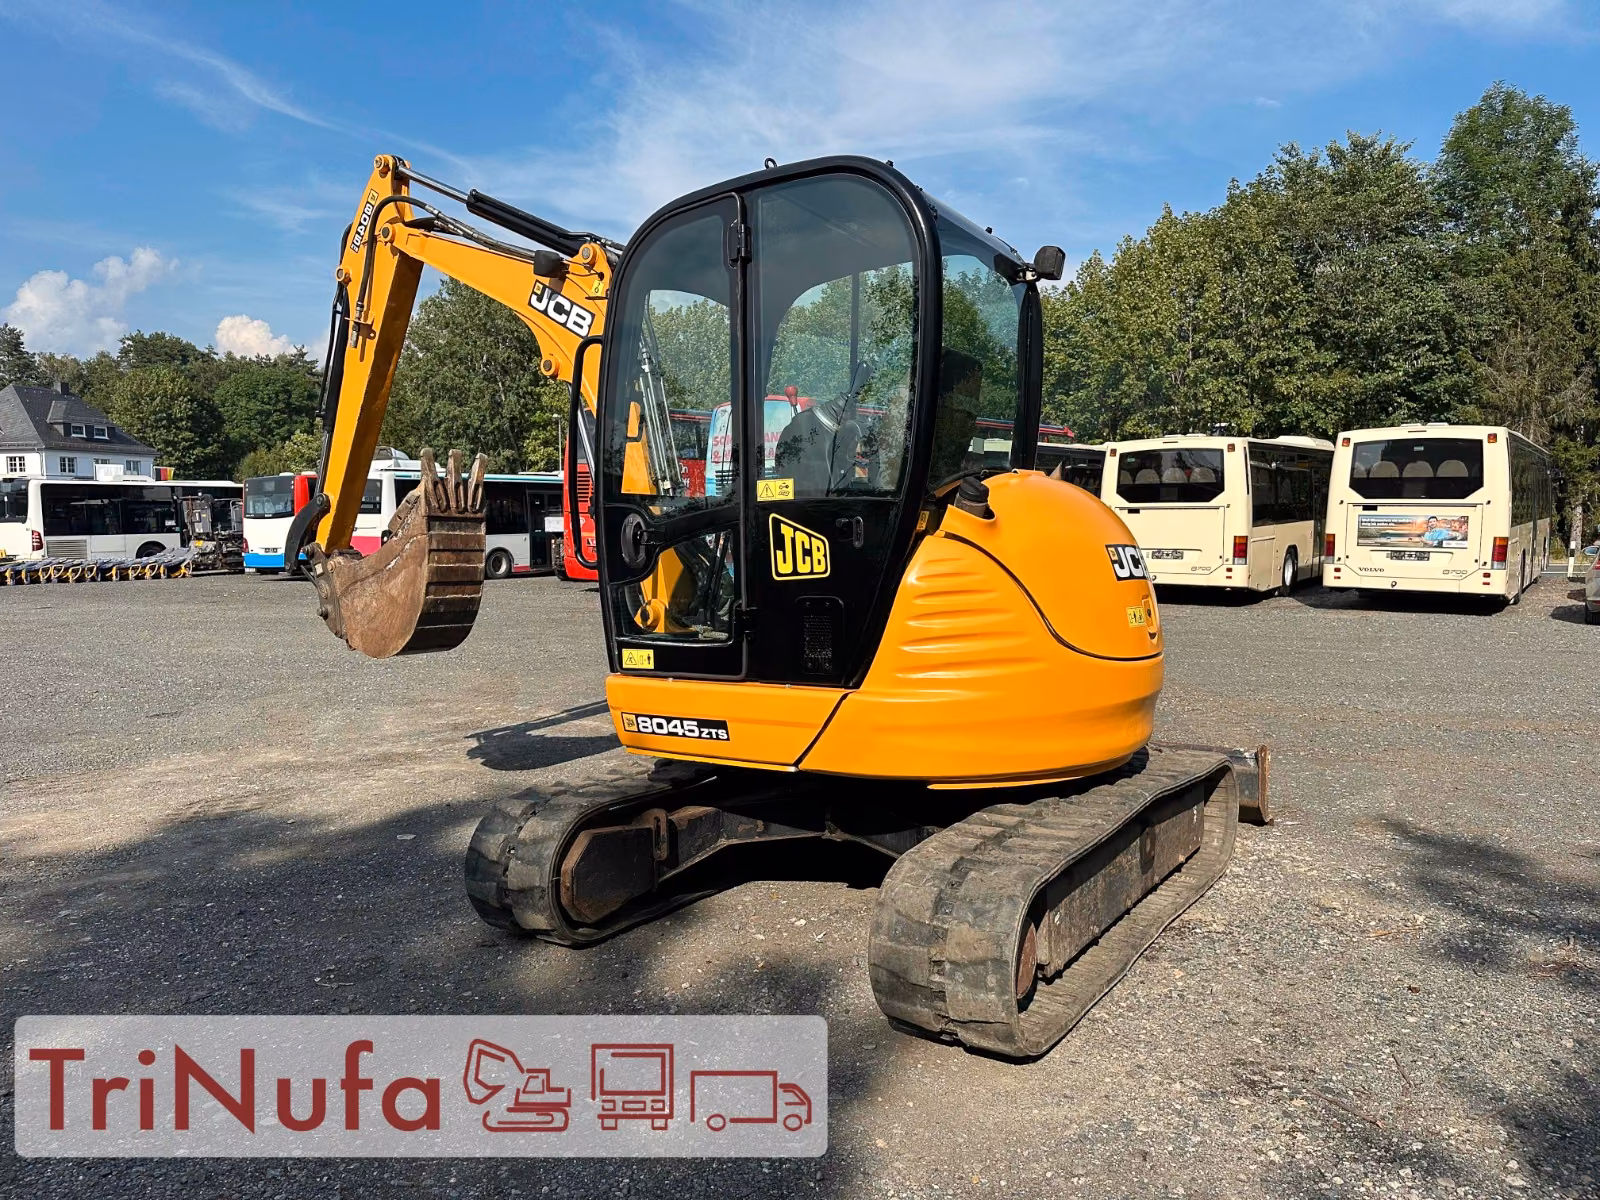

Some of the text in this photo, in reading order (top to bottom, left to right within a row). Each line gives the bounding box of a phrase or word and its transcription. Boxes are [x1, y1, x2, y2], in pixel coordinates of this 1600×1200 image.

[530, 287, 592, 337] JCB
[776, 522, 826, 574] JCB
[637, 716, 700, 737] 8045
[700, 727, 728, 740] ZTS
